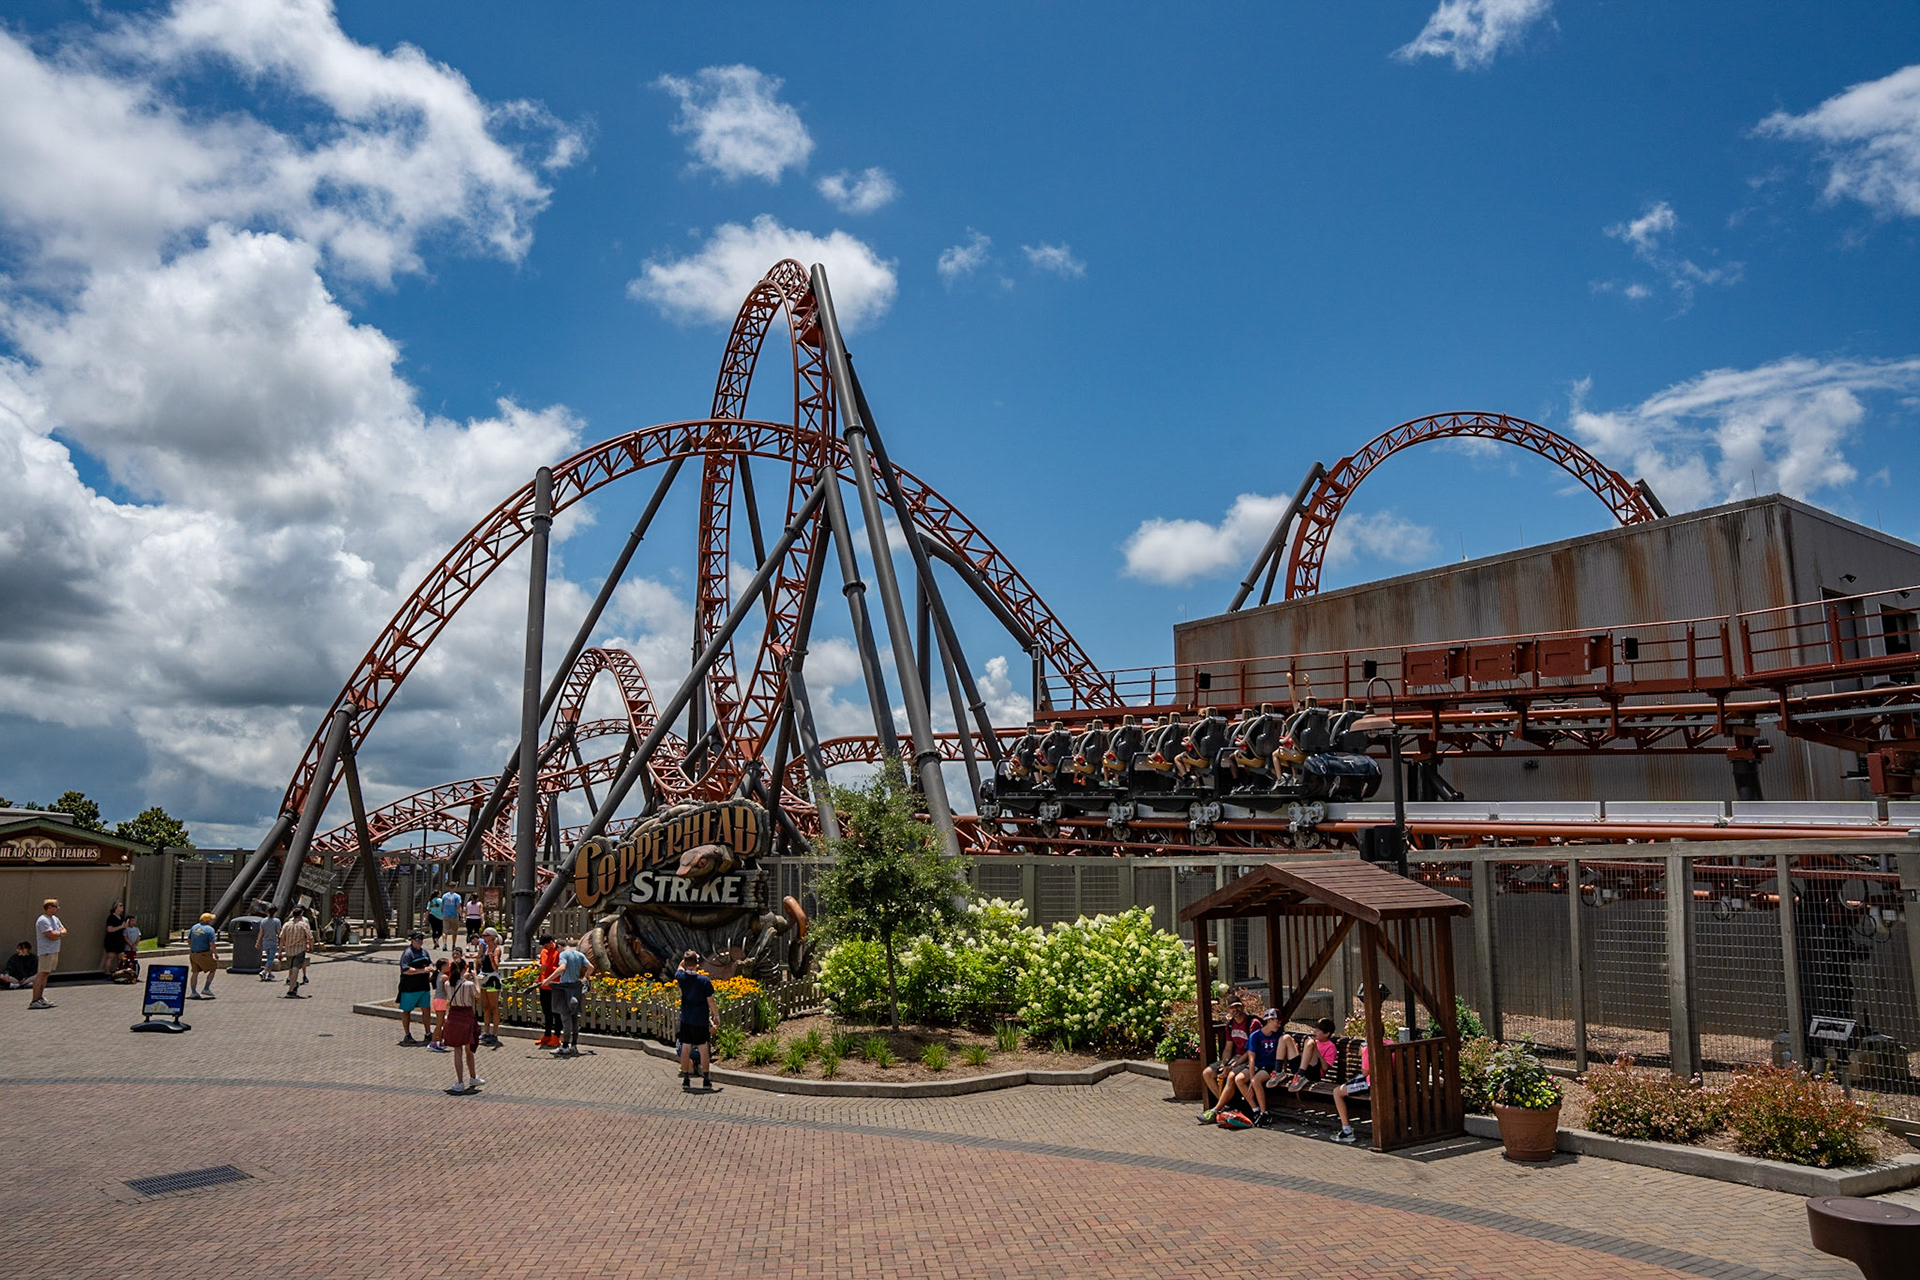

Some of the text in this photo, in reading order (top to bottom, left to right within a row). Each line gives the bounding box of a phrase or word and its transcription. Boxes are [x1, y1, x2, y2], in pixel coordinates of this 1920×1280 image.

[26, 847, 57, 858] STRIKE
[61, 848, 97, 858] TRADERS
[575, 806, 757, 907] COPPERHEAD
